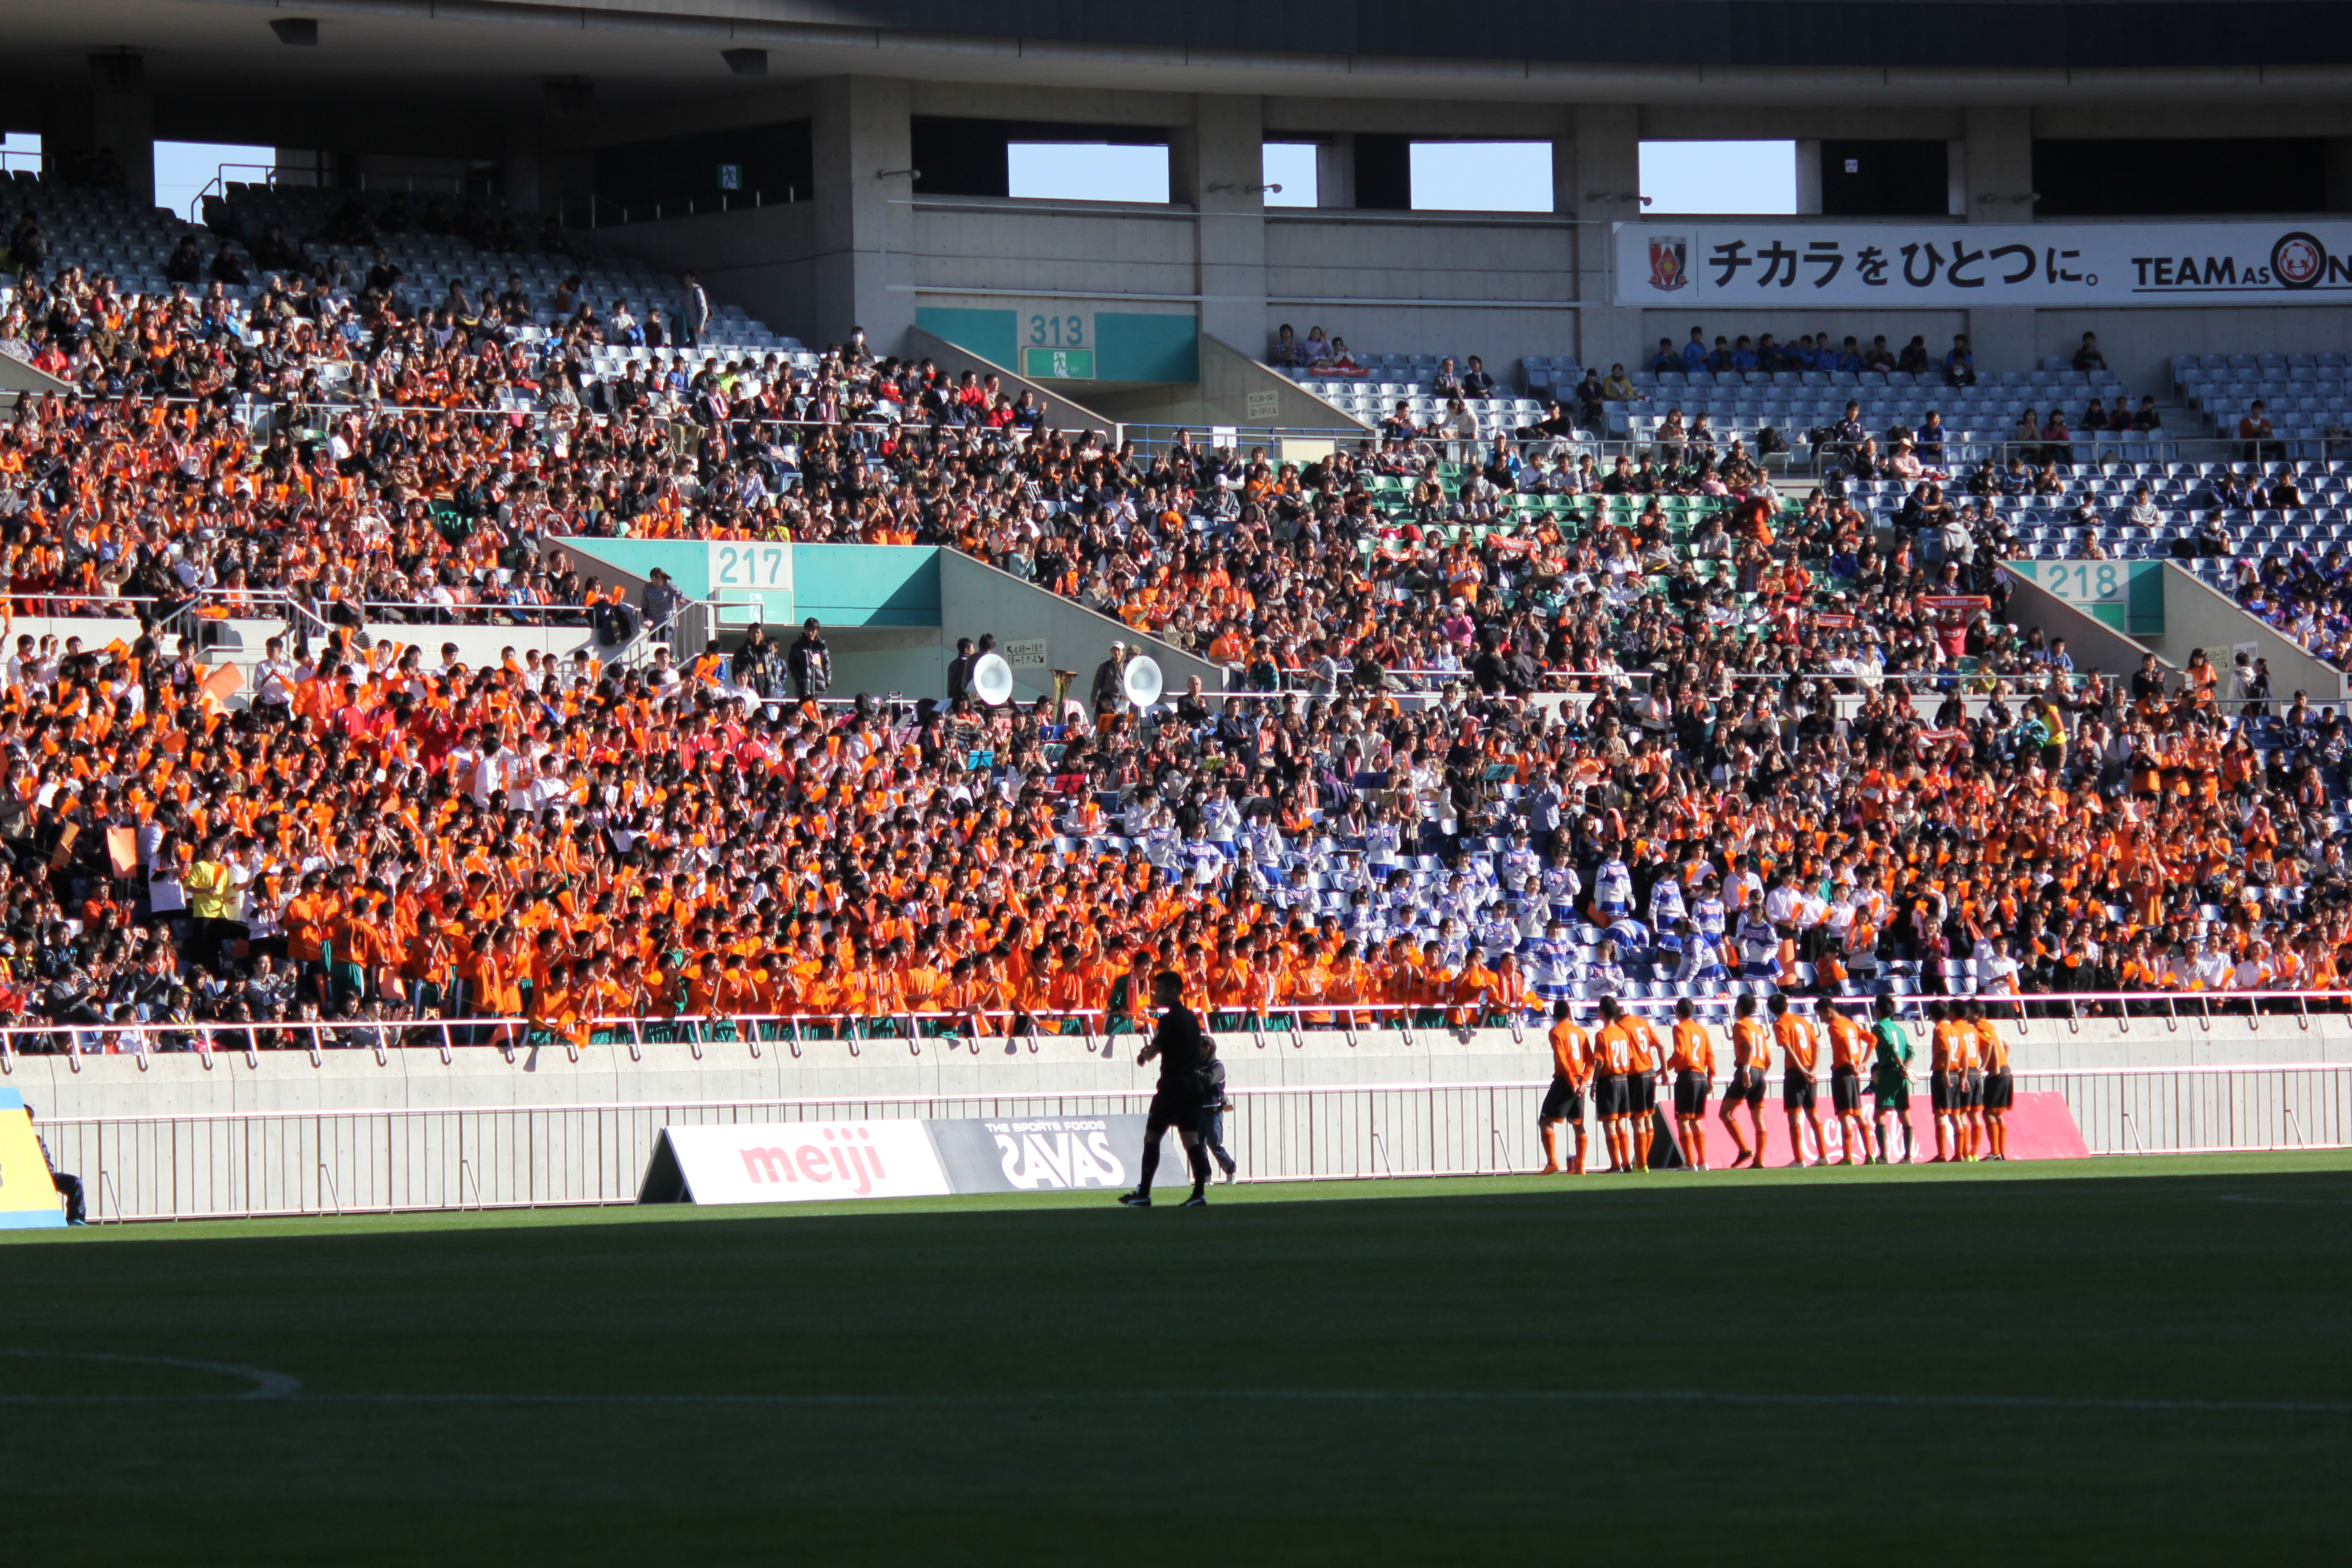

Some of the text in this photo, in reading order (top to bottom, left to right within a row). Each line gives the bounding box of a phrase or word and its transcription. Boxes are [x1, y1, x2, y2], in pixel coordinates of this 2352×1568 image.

[1709, 239, 2098, 288] チカラをひとつに。
[2132, 256, 2237, 286] TEAM
[2241, 266, 2270, 284] AS
[1030, 315, 1083, 346] 313
[720, 547, 781, 584] 217
[2049, 564, 2117, 598] 218
[1745, 930, 1766, 940] SHIKO
[1570, 1033, 1580, 1060] 9
[1637, 1027, 1648, 1054] 5
[1692, 1034, 1700, 1062] 2
[1751, 1031, 1764, 1059] 11
[1795, 1024, 1808, 1049] 3
[1847, 1029, 1858, 1054] 6
[1892, 1030, 1899, 1049] 1
[1948, 1036, 1959, 1062] 12
[1963, 1033, 1977, 1058] 16
[1611, 1039, 1630, 1068] 20
[985, 1120, 1107, 1133] THE SPORTS FOODS
[739, 1127, 886, 1196] meiji
[994, 1131, 1125, 1189] SAVAS
